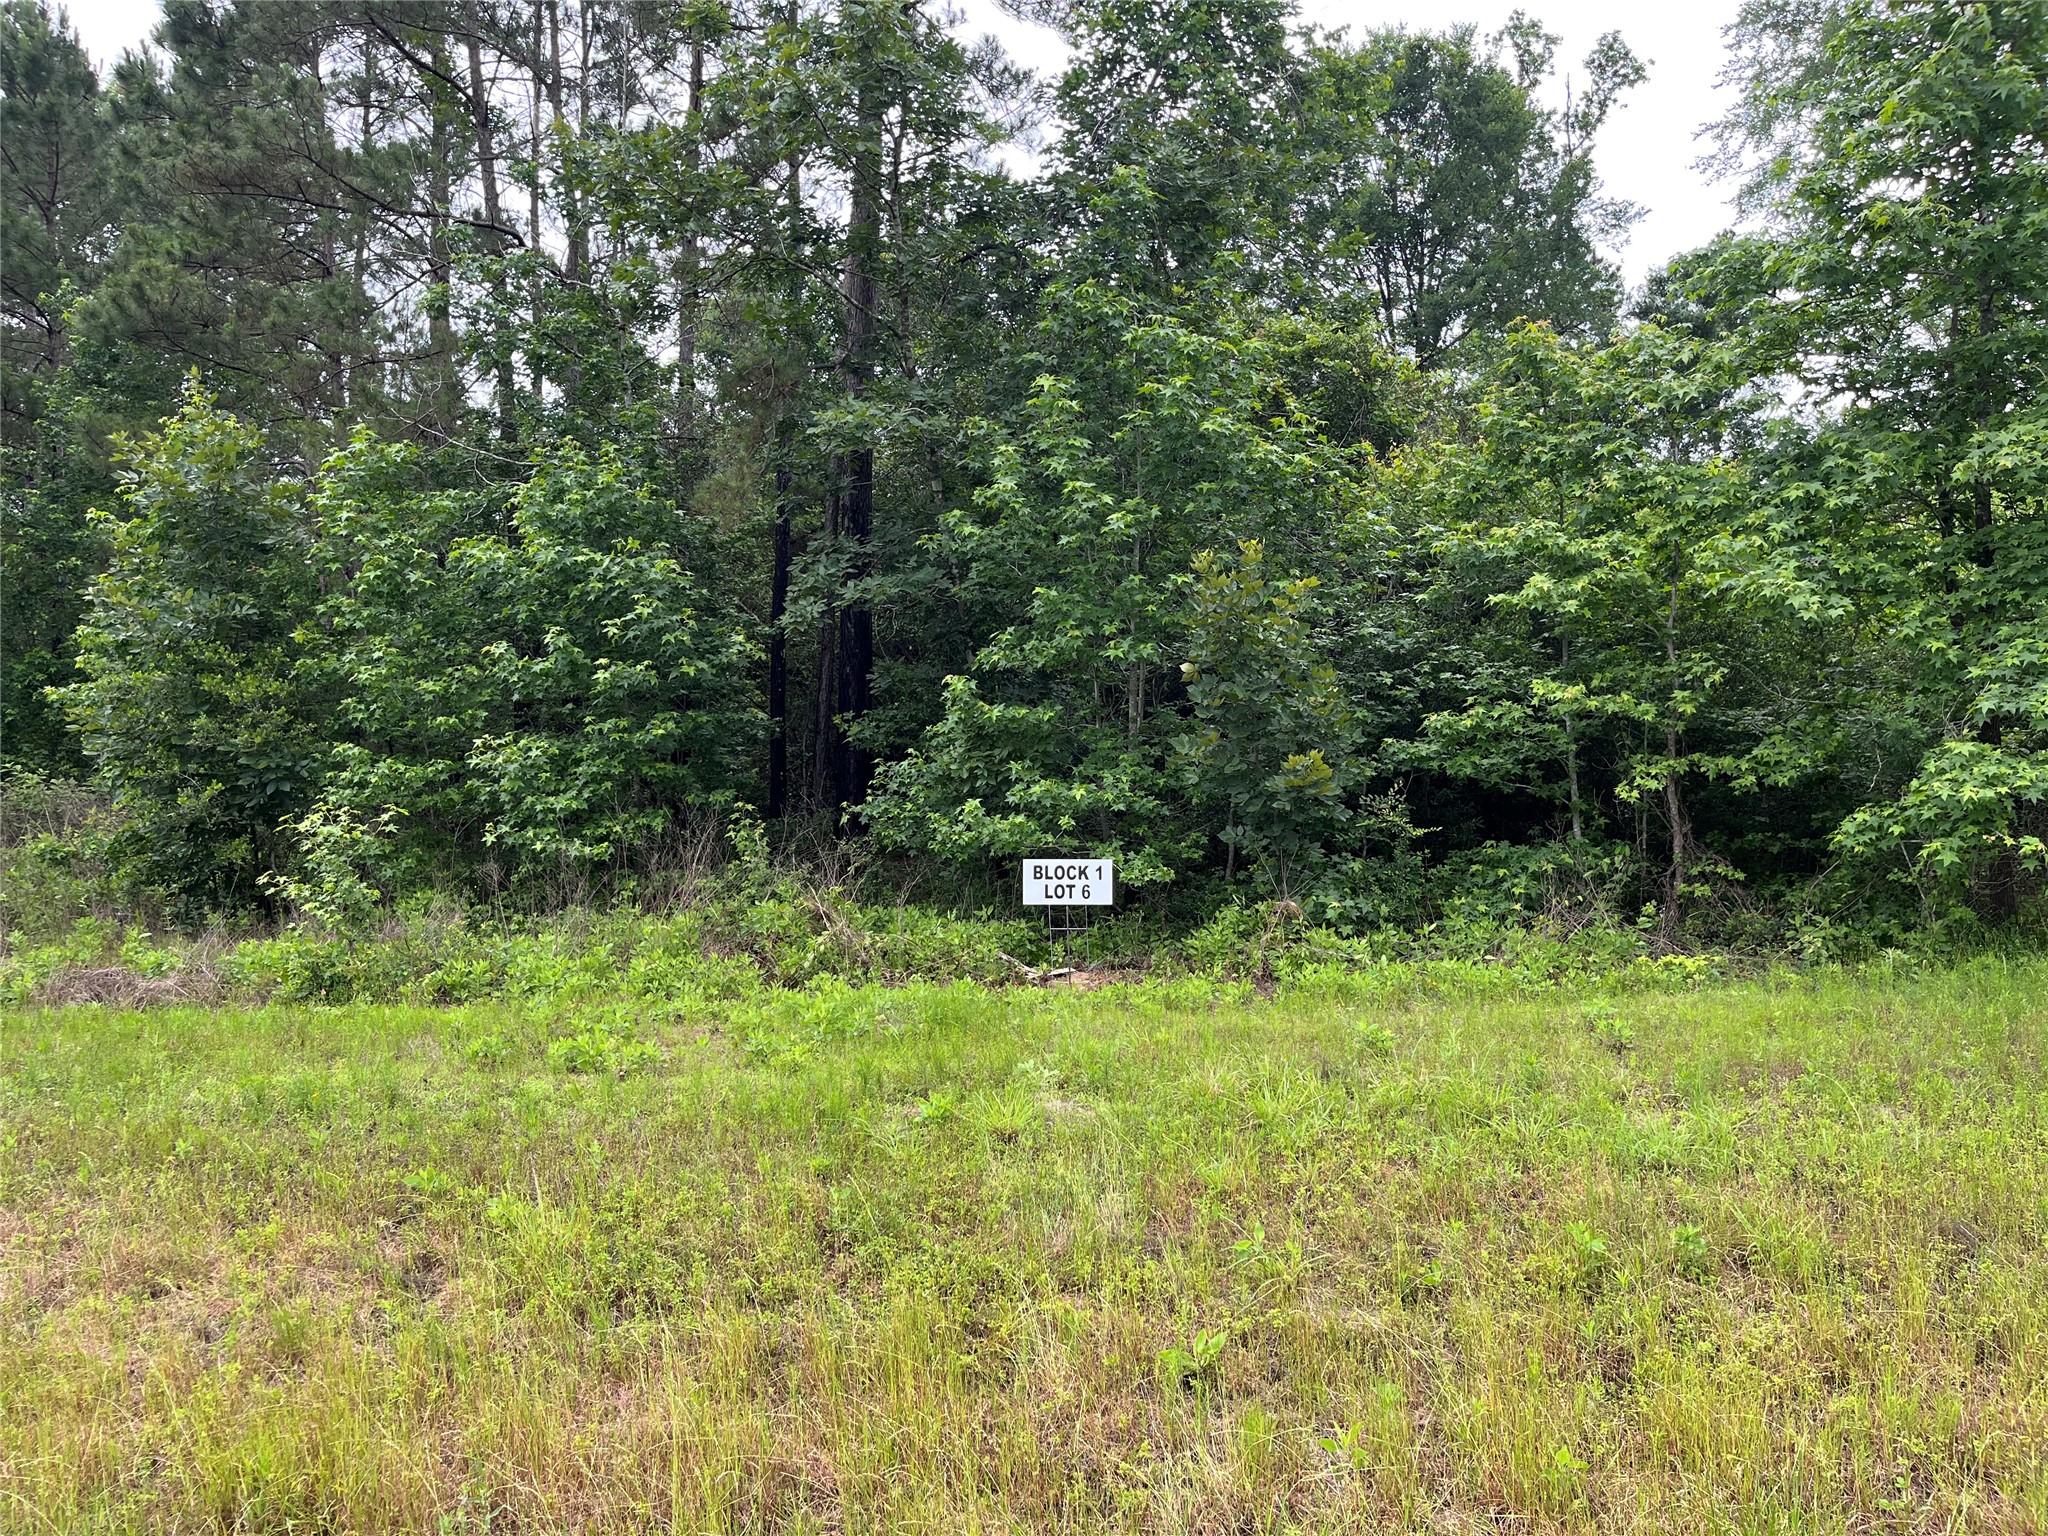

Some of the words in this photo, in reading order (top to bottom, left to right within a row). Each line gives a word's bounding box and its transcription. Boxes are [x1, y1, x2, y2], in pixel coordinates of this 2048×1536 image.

[1033, 865, 1089, 880] BLOCK
[1095, 865, 1103, 880] 1
[1044, 884, 1076, 899] LOT
[1081, 884, 1091, 899] 6
